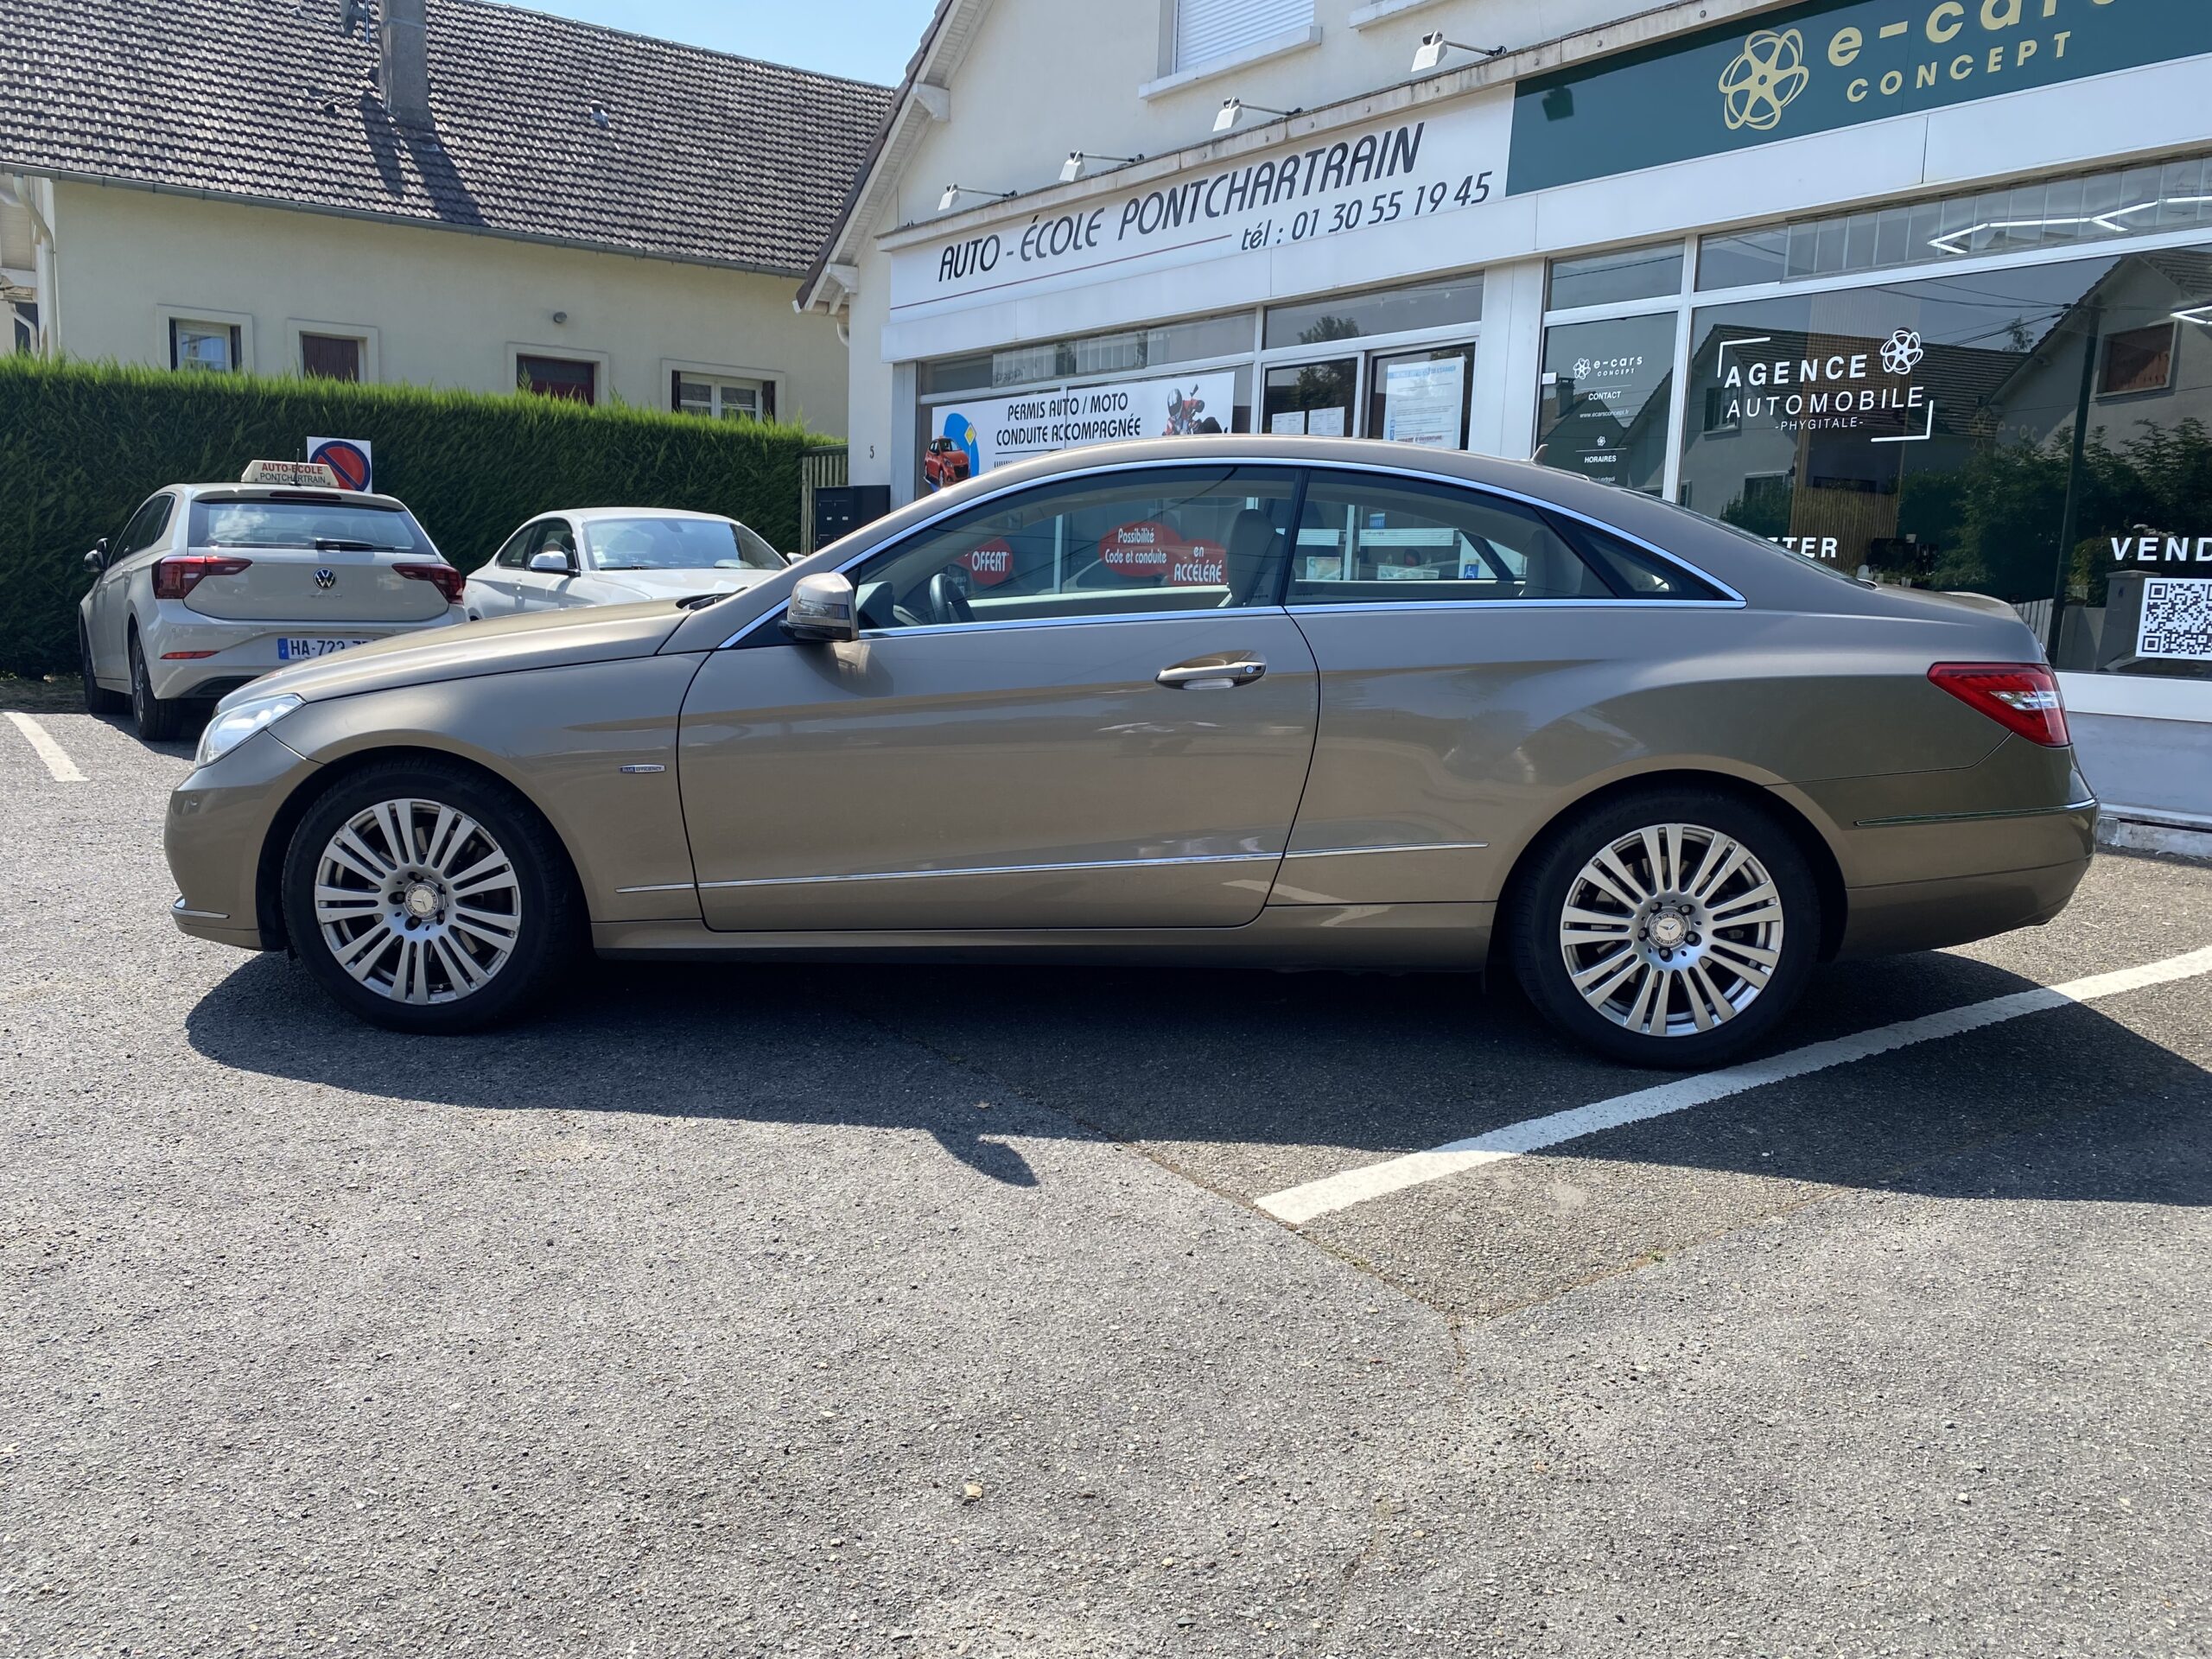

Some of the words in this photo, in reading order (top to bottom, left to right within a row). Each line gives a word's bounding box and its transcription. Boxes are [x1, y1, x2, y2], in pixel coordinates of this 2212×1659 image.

[1827, 0, 2114, 67] e-ca
[1847, 31, 2071, 103] CONCEPT
[1118, 122, 1425, 241] PONTCHARTRAIN
[1292, 208, 1319, 240] 01
[1328, 200, 1363, 232] 30
[1368, 190, 1403, 225] 55
[1414, 181, 1447, 215] 19
[1453, 171, 1492, 206] 45
[1593, 356, 1643, 369] e-cars
[1597, 368, 1635, 377] CONCEPT
[1724, 354, 1867, 389] AGENCE
[1007, 401, 1046, 422] PERMIS
[1051, 398, 1079, 417] AUTO
[1090, 392, 1128, 414] MOTO
[1588, 391, 1622, 401] CONTACT
[1726, 386, 1924, 419] AUTOMOBILE
[996, 426, 1047, 447] CONDUITE
[1052, 414, 1141, 442] ACCOMPAGNÉE
[869, 446, 874, 459] 5
[1585, 454, 1617, 463] HORAIRES
[1117, 528, 1154, 543] Possibilité
[1105, 549, 1123, 563] Code
[1125, 550, 1133, 563] et
[1135, 549, 1166, 564] conduite
[1193, 546, 1205, 557] en
[1174, 559, 1223, 583] ACCÉLÉRÉ
